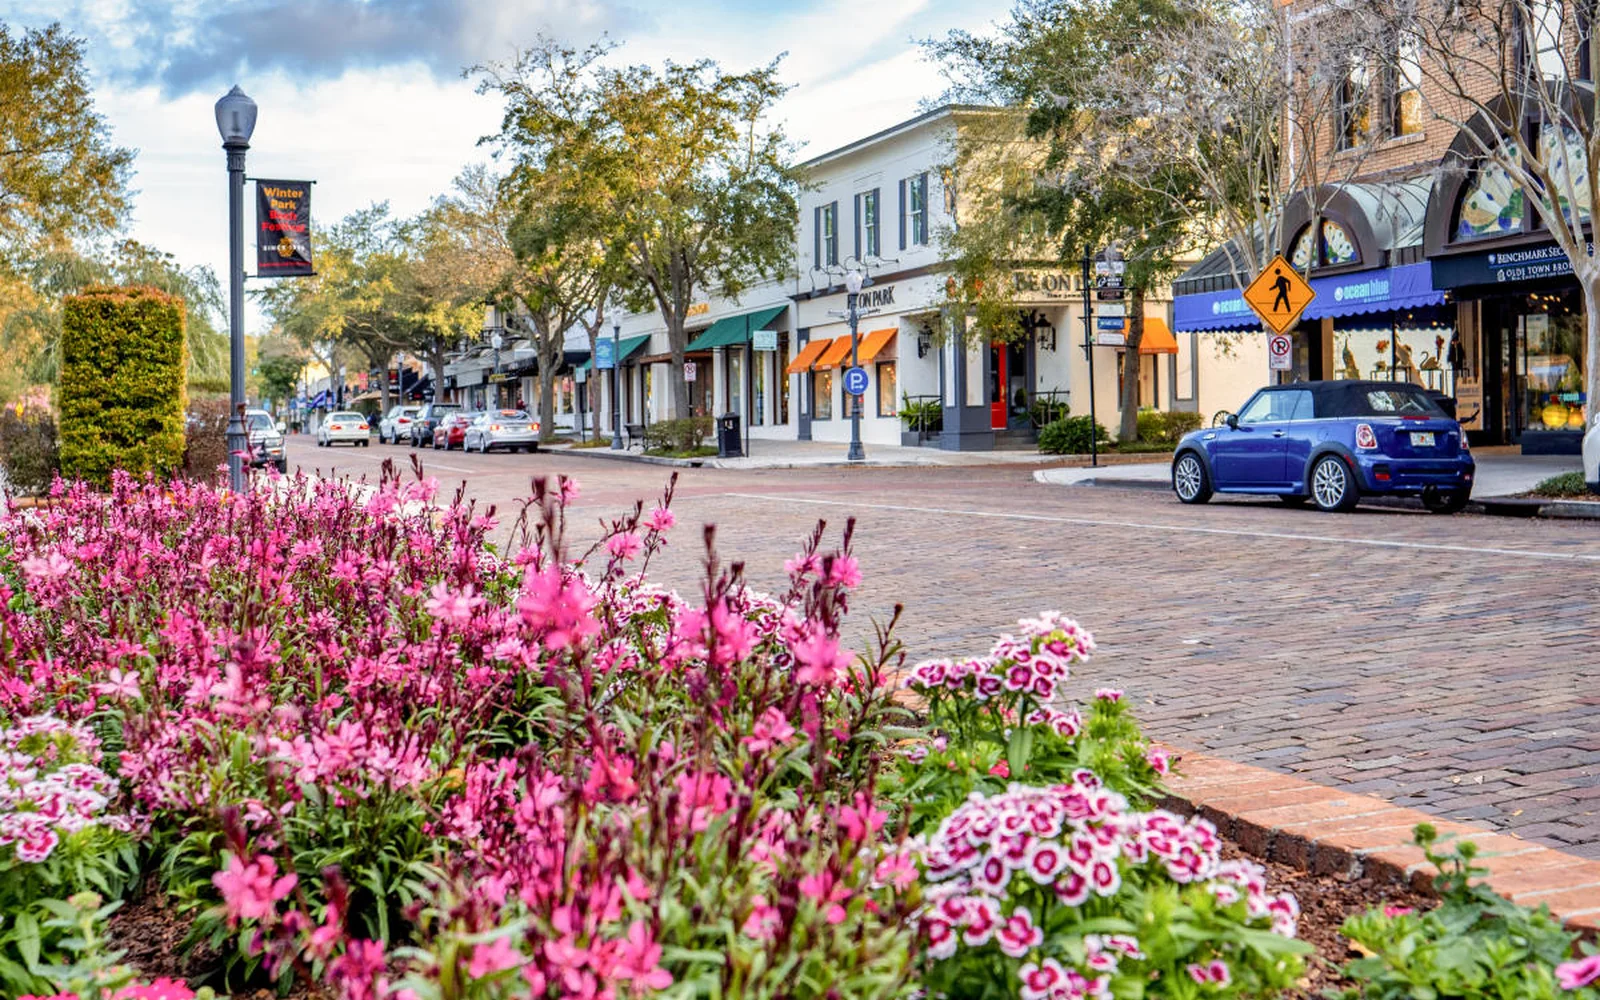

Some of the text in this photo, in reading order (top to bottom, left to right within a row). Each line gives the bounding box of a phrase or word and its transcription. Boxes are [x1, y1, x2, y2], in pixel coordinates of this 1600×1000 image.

[263, 187, 303, 198] Winter
[270, 199, 296, 210] Park
[1497, 247, 1548, 264] BENCHMARK
[1506, 268, 1526, 278] OLDE
[1527, 264, 1550, 275] TOWN
[1042, 274, 1071, 291] ON
[860, 292, 872, 308] ON
[873, 286, 896, 307] PARK
